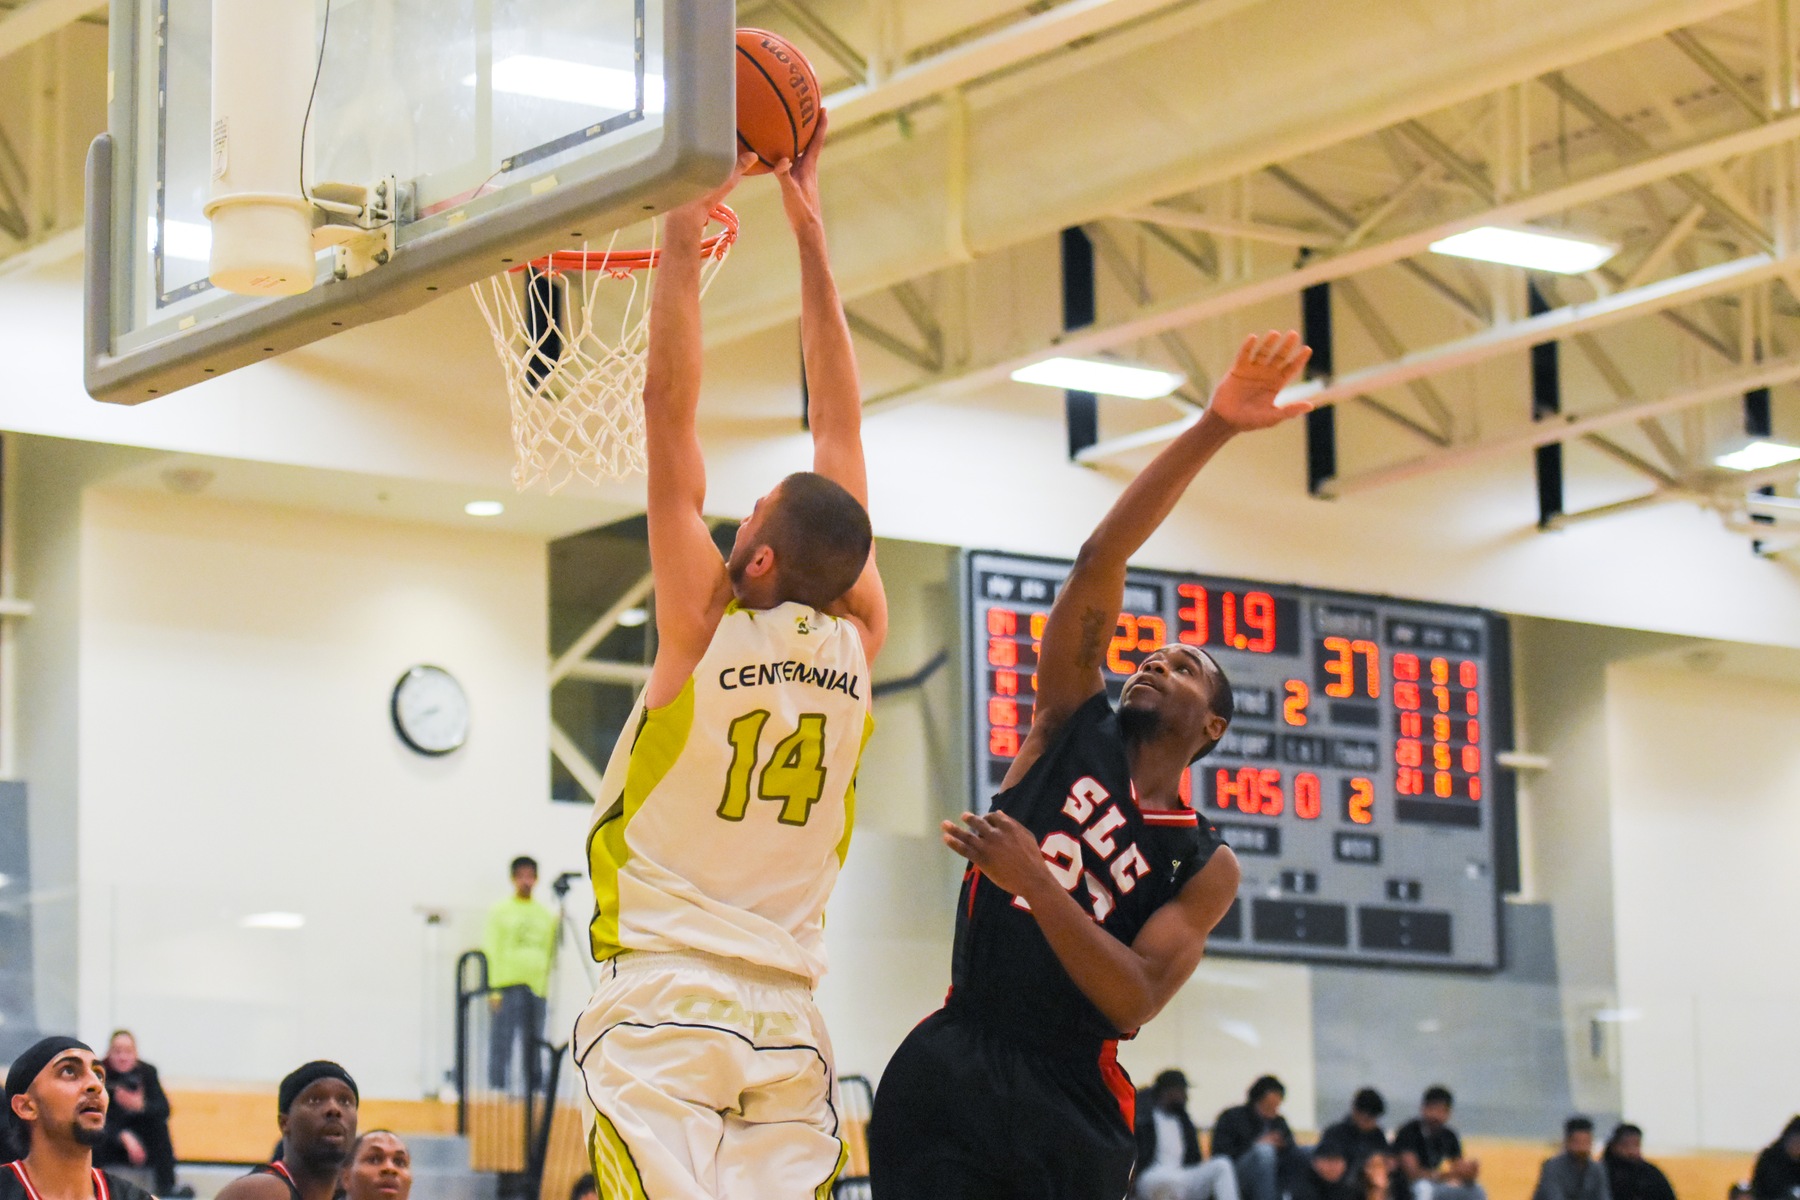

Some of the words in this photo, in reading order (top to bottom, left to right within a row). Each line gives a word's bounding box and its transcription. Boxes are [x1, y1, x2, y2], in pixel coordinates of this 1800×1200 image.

[760, 39, 815, 129] Wilson
[1178, 583, 1276, 653] 31.9
[719, 660, 860, 701] CENTENNIAL
[1323, 636, 1380, 699] 37
[1283, 679, 1310, 727] 2
[1466, 690, 1479, 717] 1
[1467, 718, 1480, 745] 1
[716, 708, 828, 827] 14
[1468, 776, 1482, 801] 1
[1349, 777, 1375, 825] 2
[1060, 775, 1152, 896] SLC
